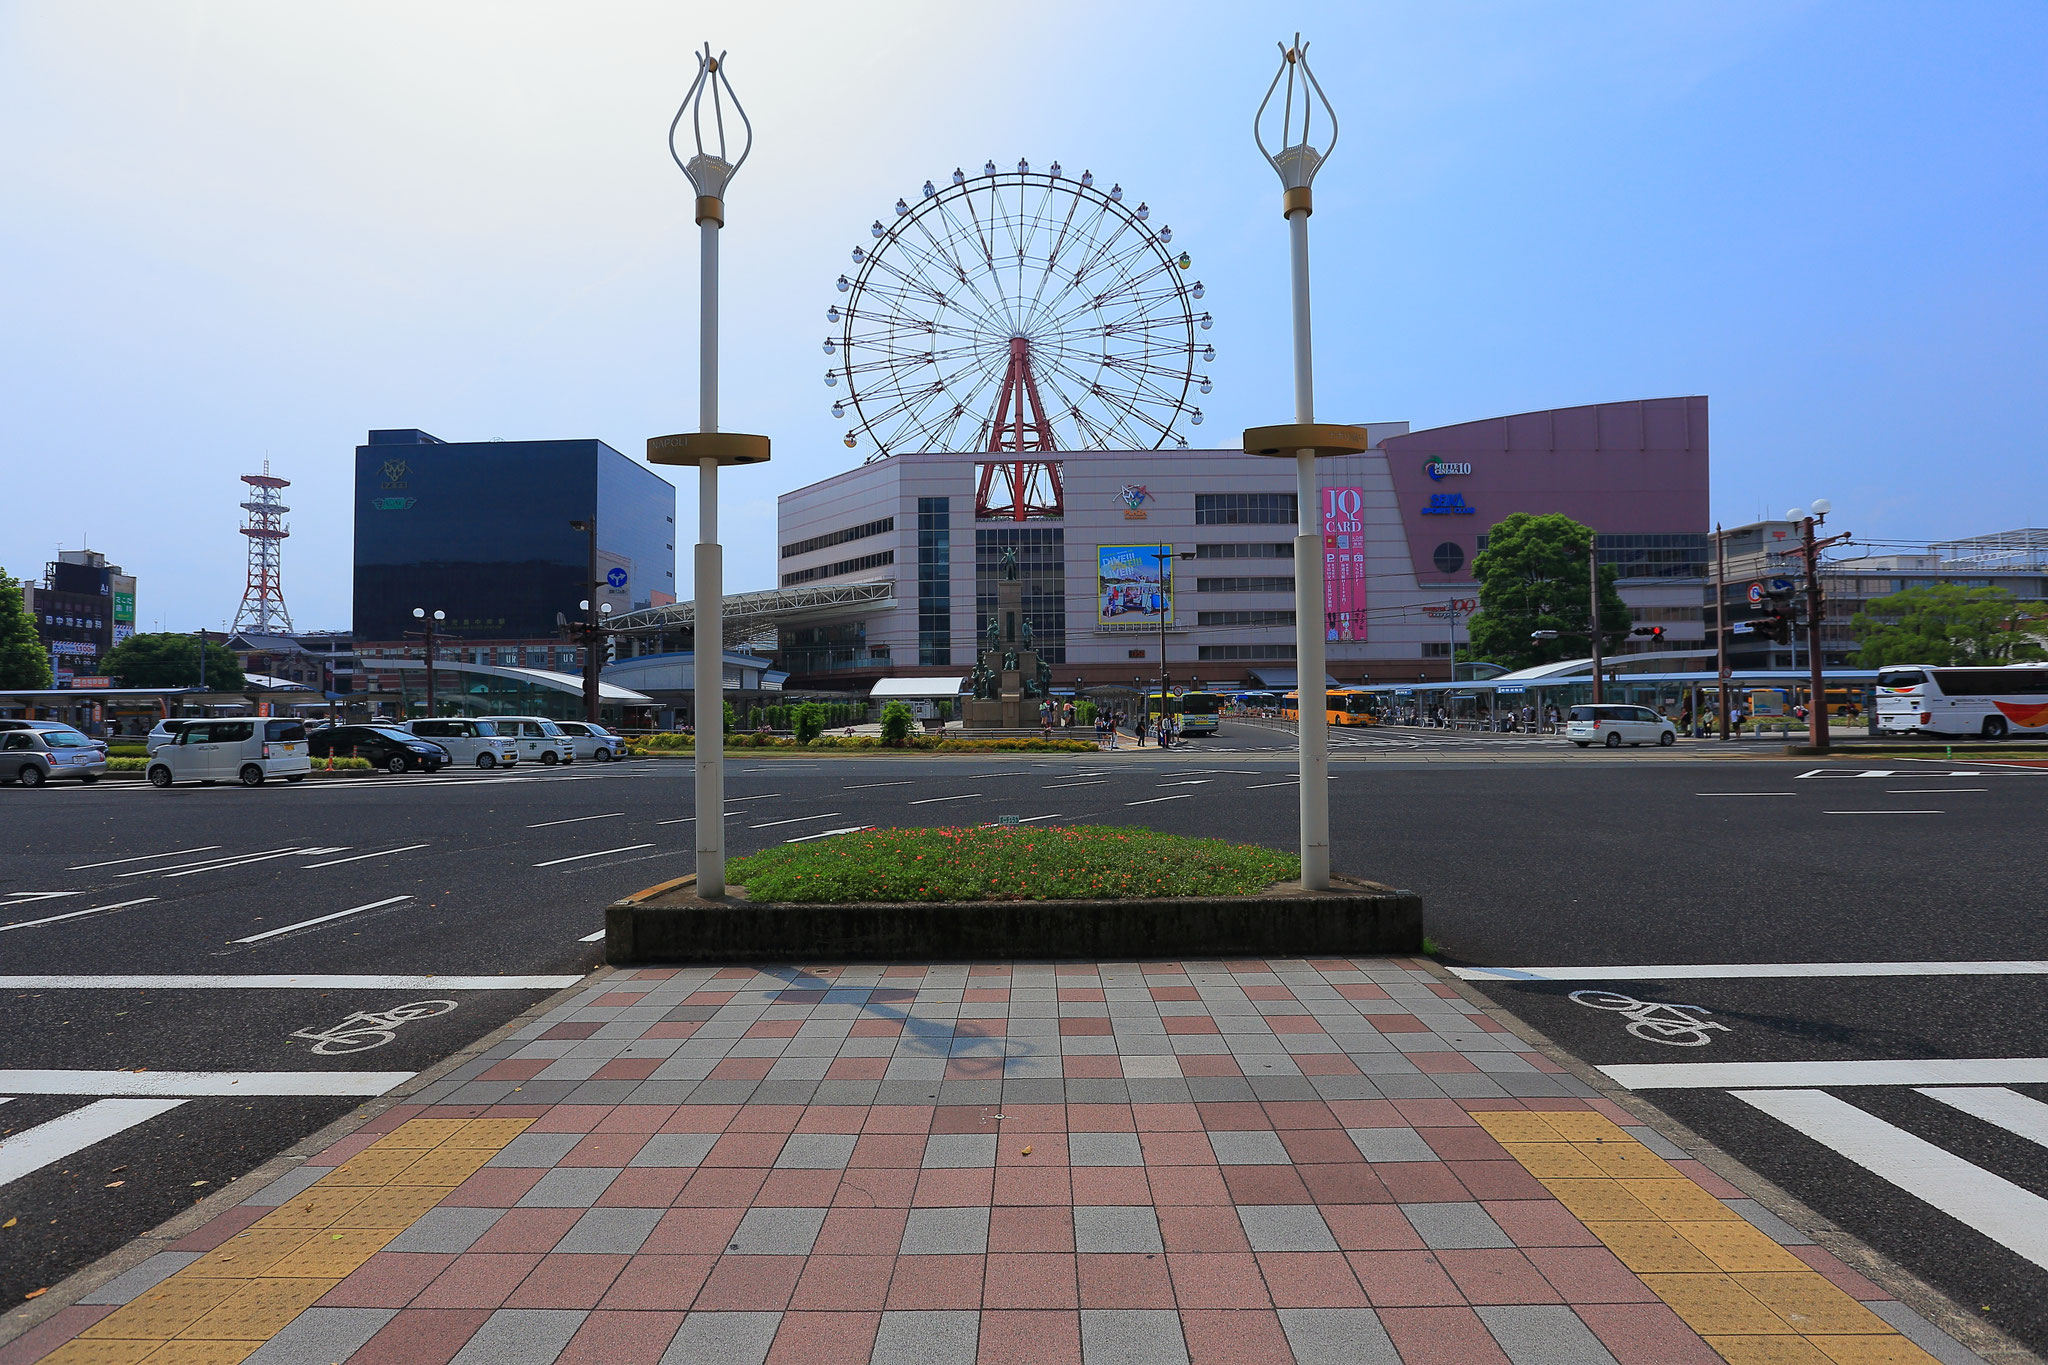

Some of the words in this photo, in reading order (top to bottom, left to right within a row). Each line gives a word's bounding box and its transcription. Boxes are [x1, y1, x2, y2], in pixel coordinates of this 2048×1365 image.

[652, 437, 688, 449] NAPOLI
[1459, 462, 1472, 475] 10
[1326, 489, 1361, 521] JQ
[1431, 493, 1466, 507] SEIKA
[1326, 521, 1362, 533] CARD
[46, 615, 102, 629] 田中矯正歯科
[506, 654, 517, 664] UR
[563, 654, 574, 663] UR
